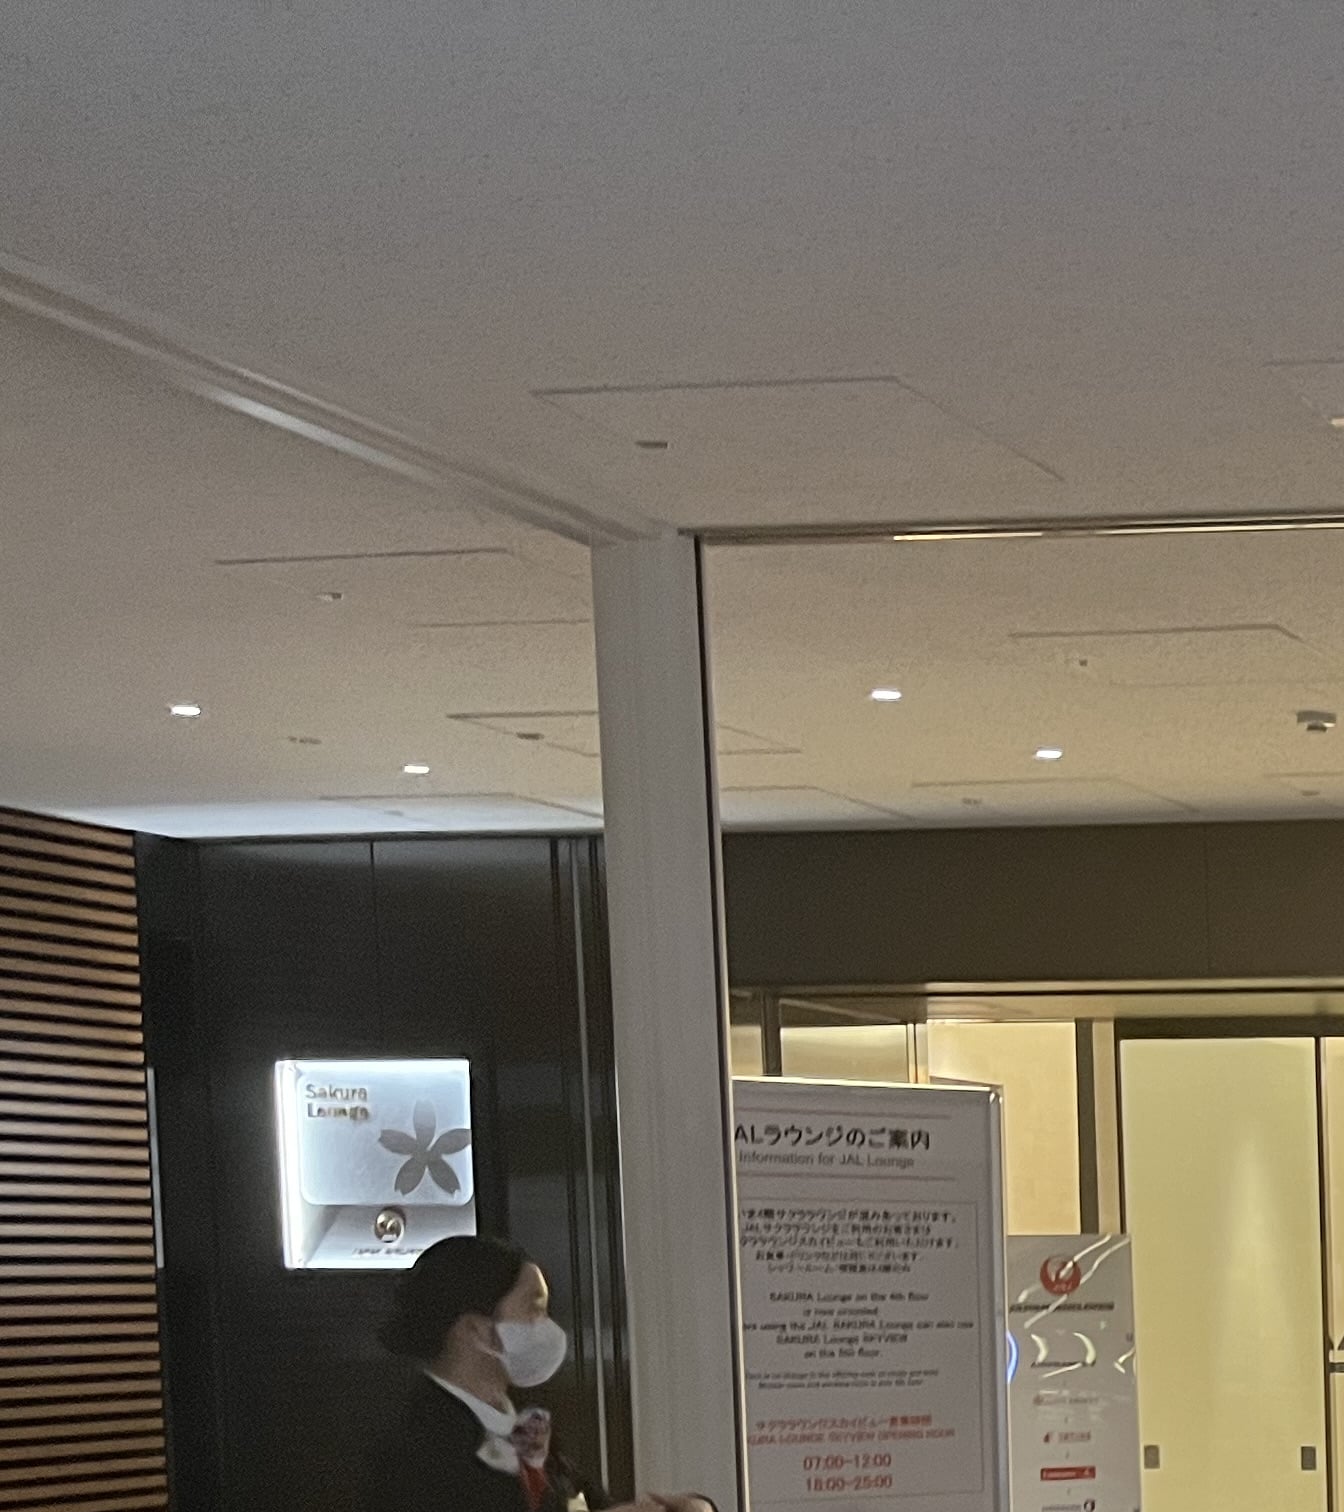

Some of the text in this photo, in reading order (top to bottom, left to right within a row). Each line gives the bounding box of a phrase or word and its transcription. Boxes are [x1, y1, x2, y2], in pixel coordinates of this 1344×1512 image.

[305, 1083, 368, 1102] Sakura
[739, 1150, 915, 1169] Information for JAL Lounge
